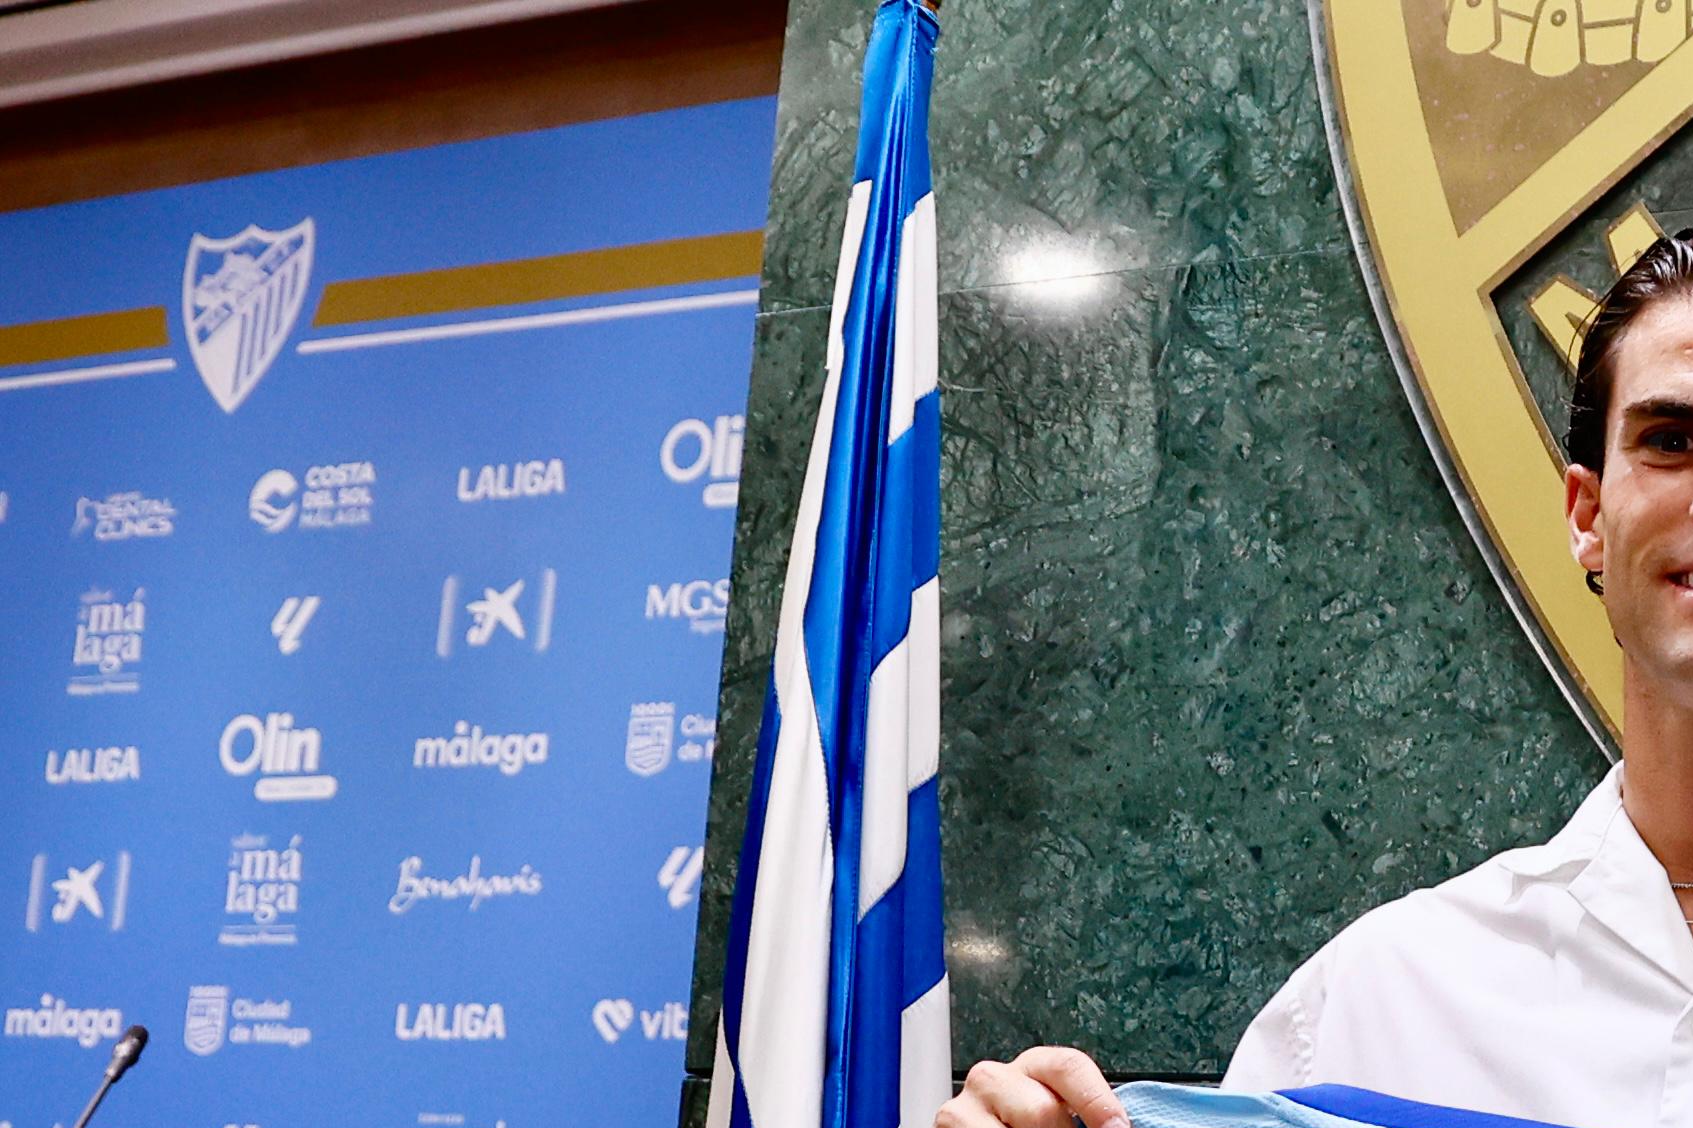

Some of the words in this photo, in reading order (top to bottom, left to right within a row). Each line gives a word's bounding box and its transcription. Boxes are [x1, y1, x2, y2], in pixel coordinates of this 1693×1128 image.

[304, 461, 376, 490] COSTA
[456, 458, 566, 501] LALIGA
[219, 712, 322, 777] Olin
[45, 746, 141, 784] LALIGA
[396, 1003, 506, 1041] LALIGA
